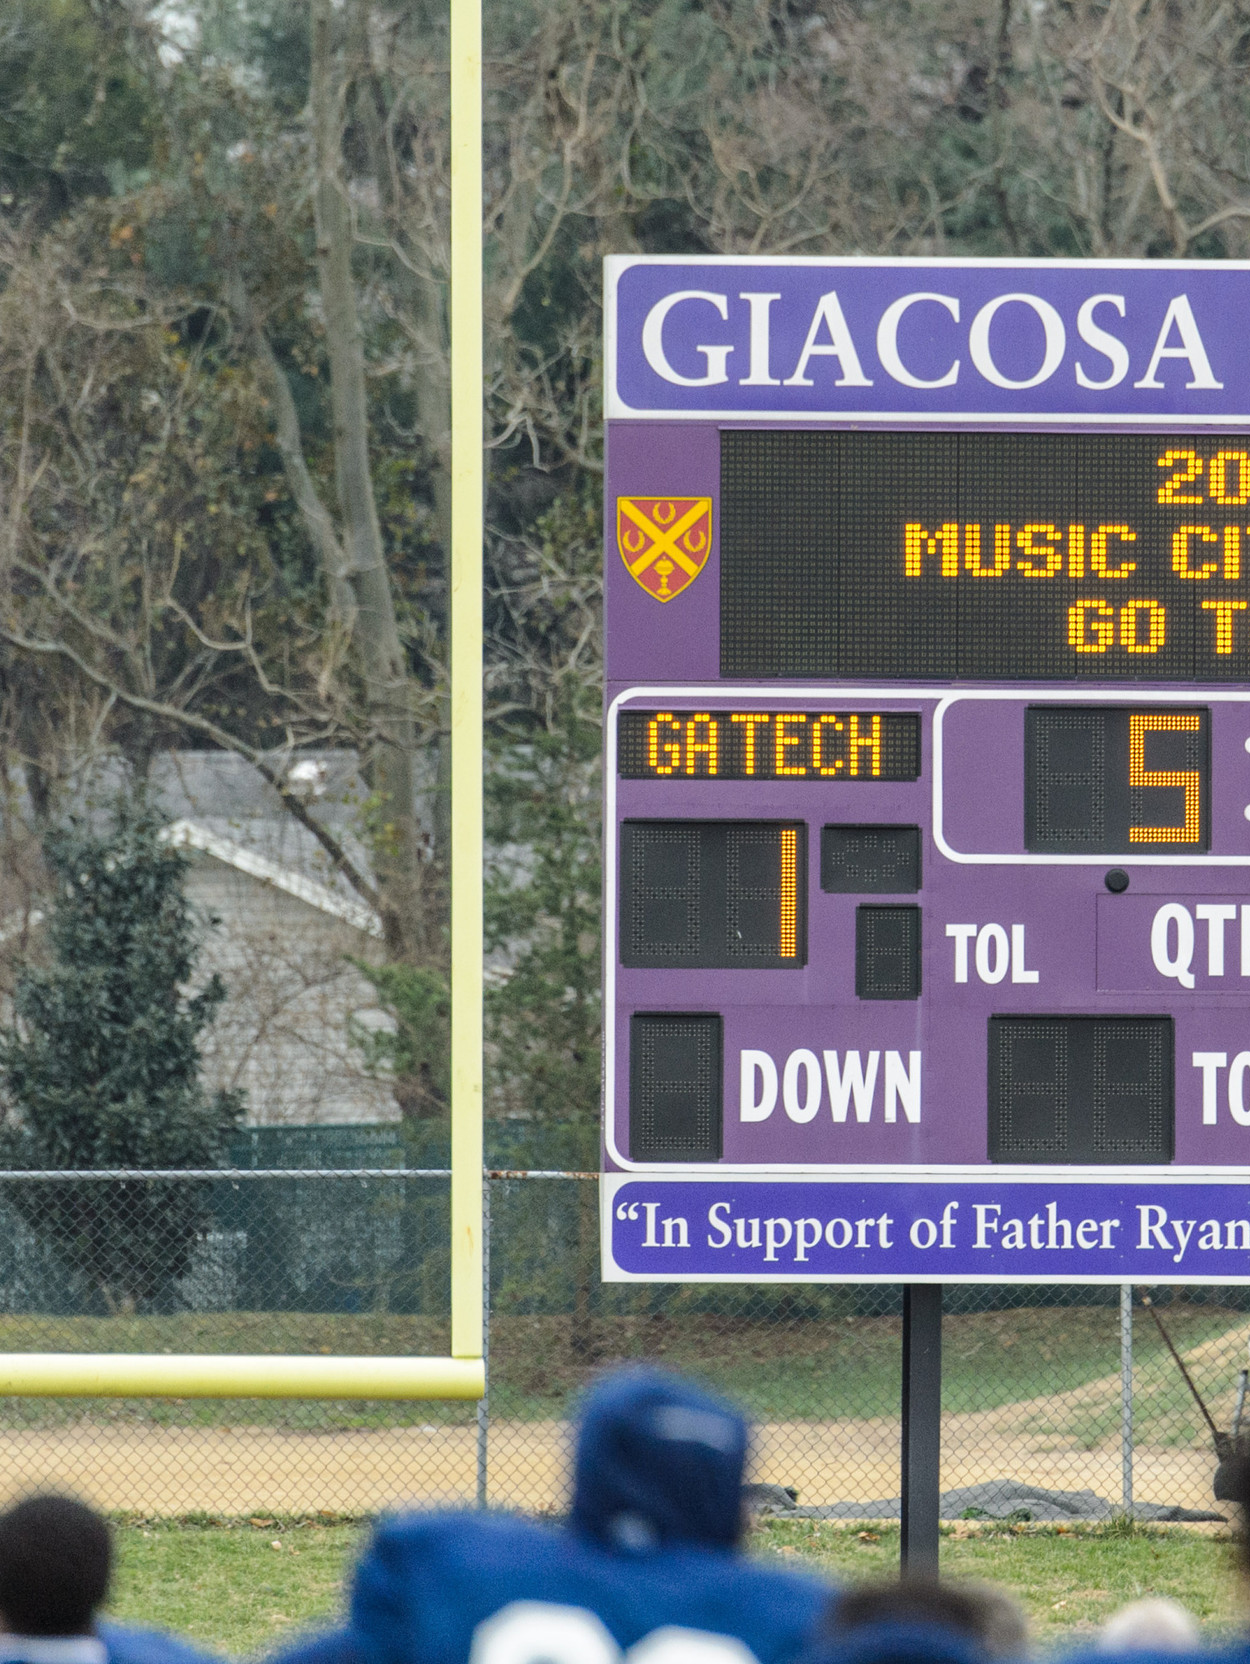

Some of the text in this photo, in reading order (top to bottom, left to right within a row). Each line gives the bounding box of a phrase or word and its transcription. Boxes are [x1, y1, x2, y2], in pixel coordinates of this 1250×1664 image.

[641, 289, 1224, 390] GIACOSA
[905, 522, 1137, 579] MUSIC
[1068, 599, 1166, 654] GO
[780, 829, 797, 958] 1
[945, 923, 1039, 984] TOL
[739, 1049, 922, 1124] DOWN
[707, 1202, 894, 1261] Support
[909, 1201, 959, 1249] of
[972, 1202, 1121, 1249] Father
